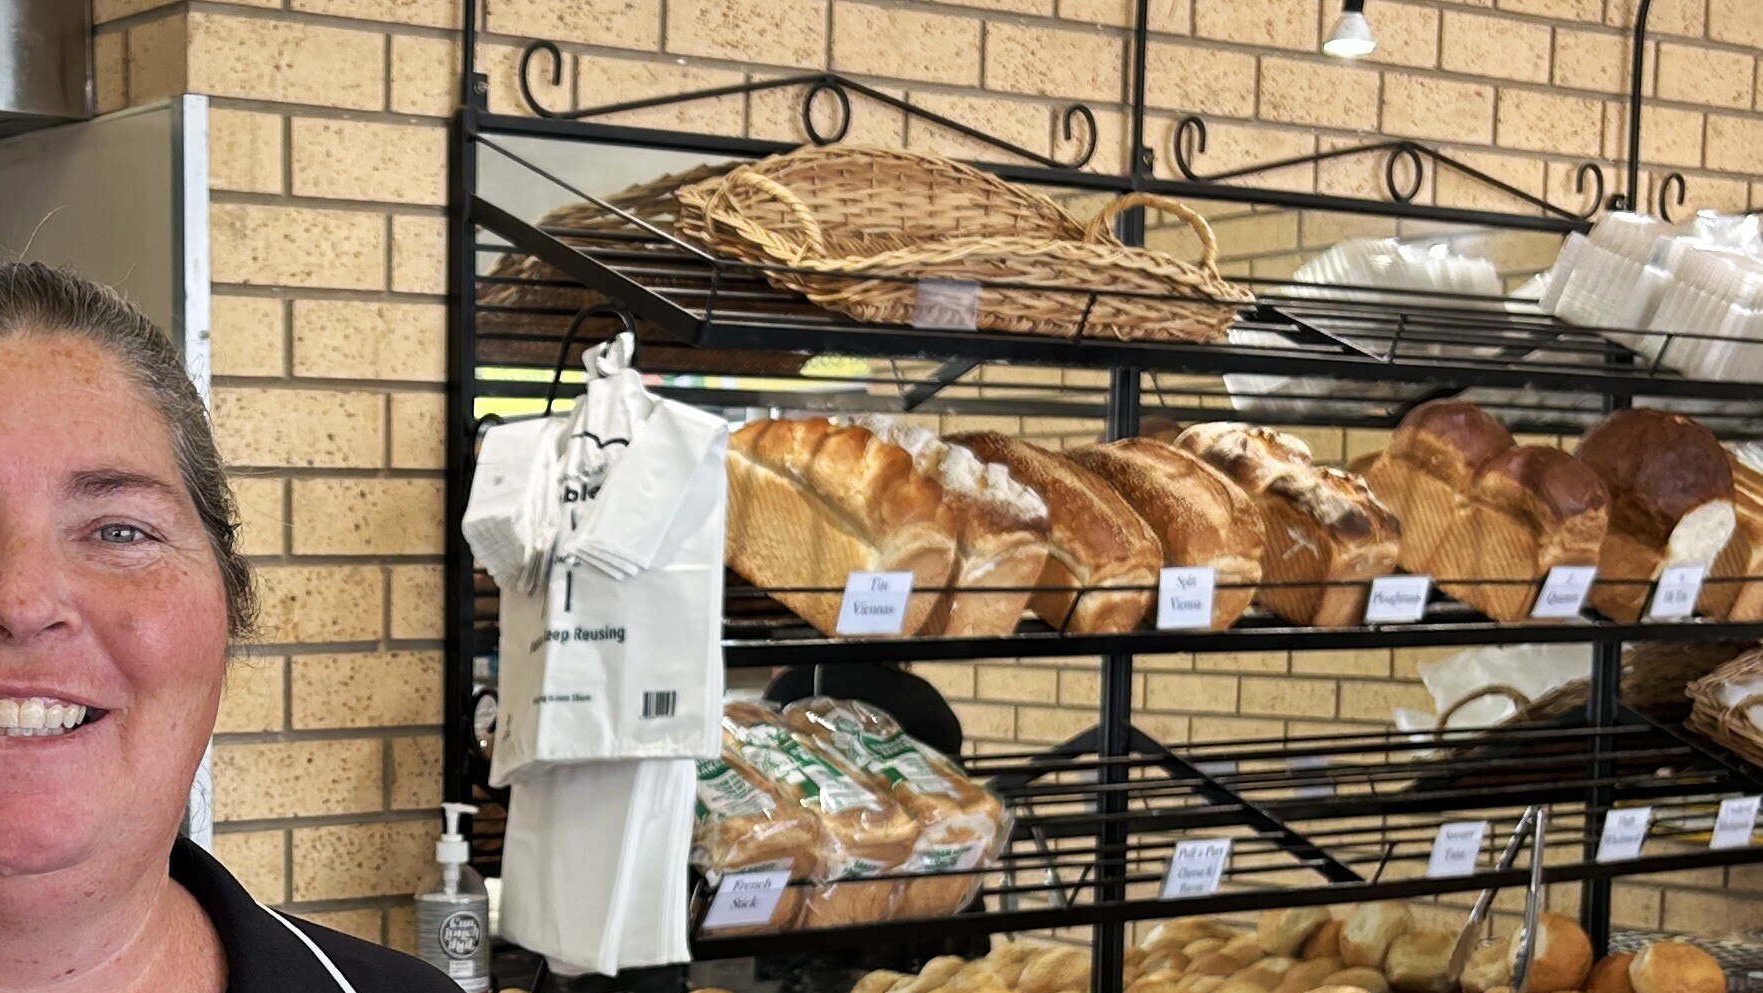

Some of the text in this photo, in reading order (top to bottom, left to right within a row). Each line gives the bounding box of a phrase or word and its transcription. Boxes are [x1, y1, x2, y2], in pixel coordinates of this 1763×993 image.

[870, 575, 888, 592] Tin
[853, 600, 894, 616] Viennas
[574, 625, 625, 643] Reusing
[732, 877, 772, 891] French
